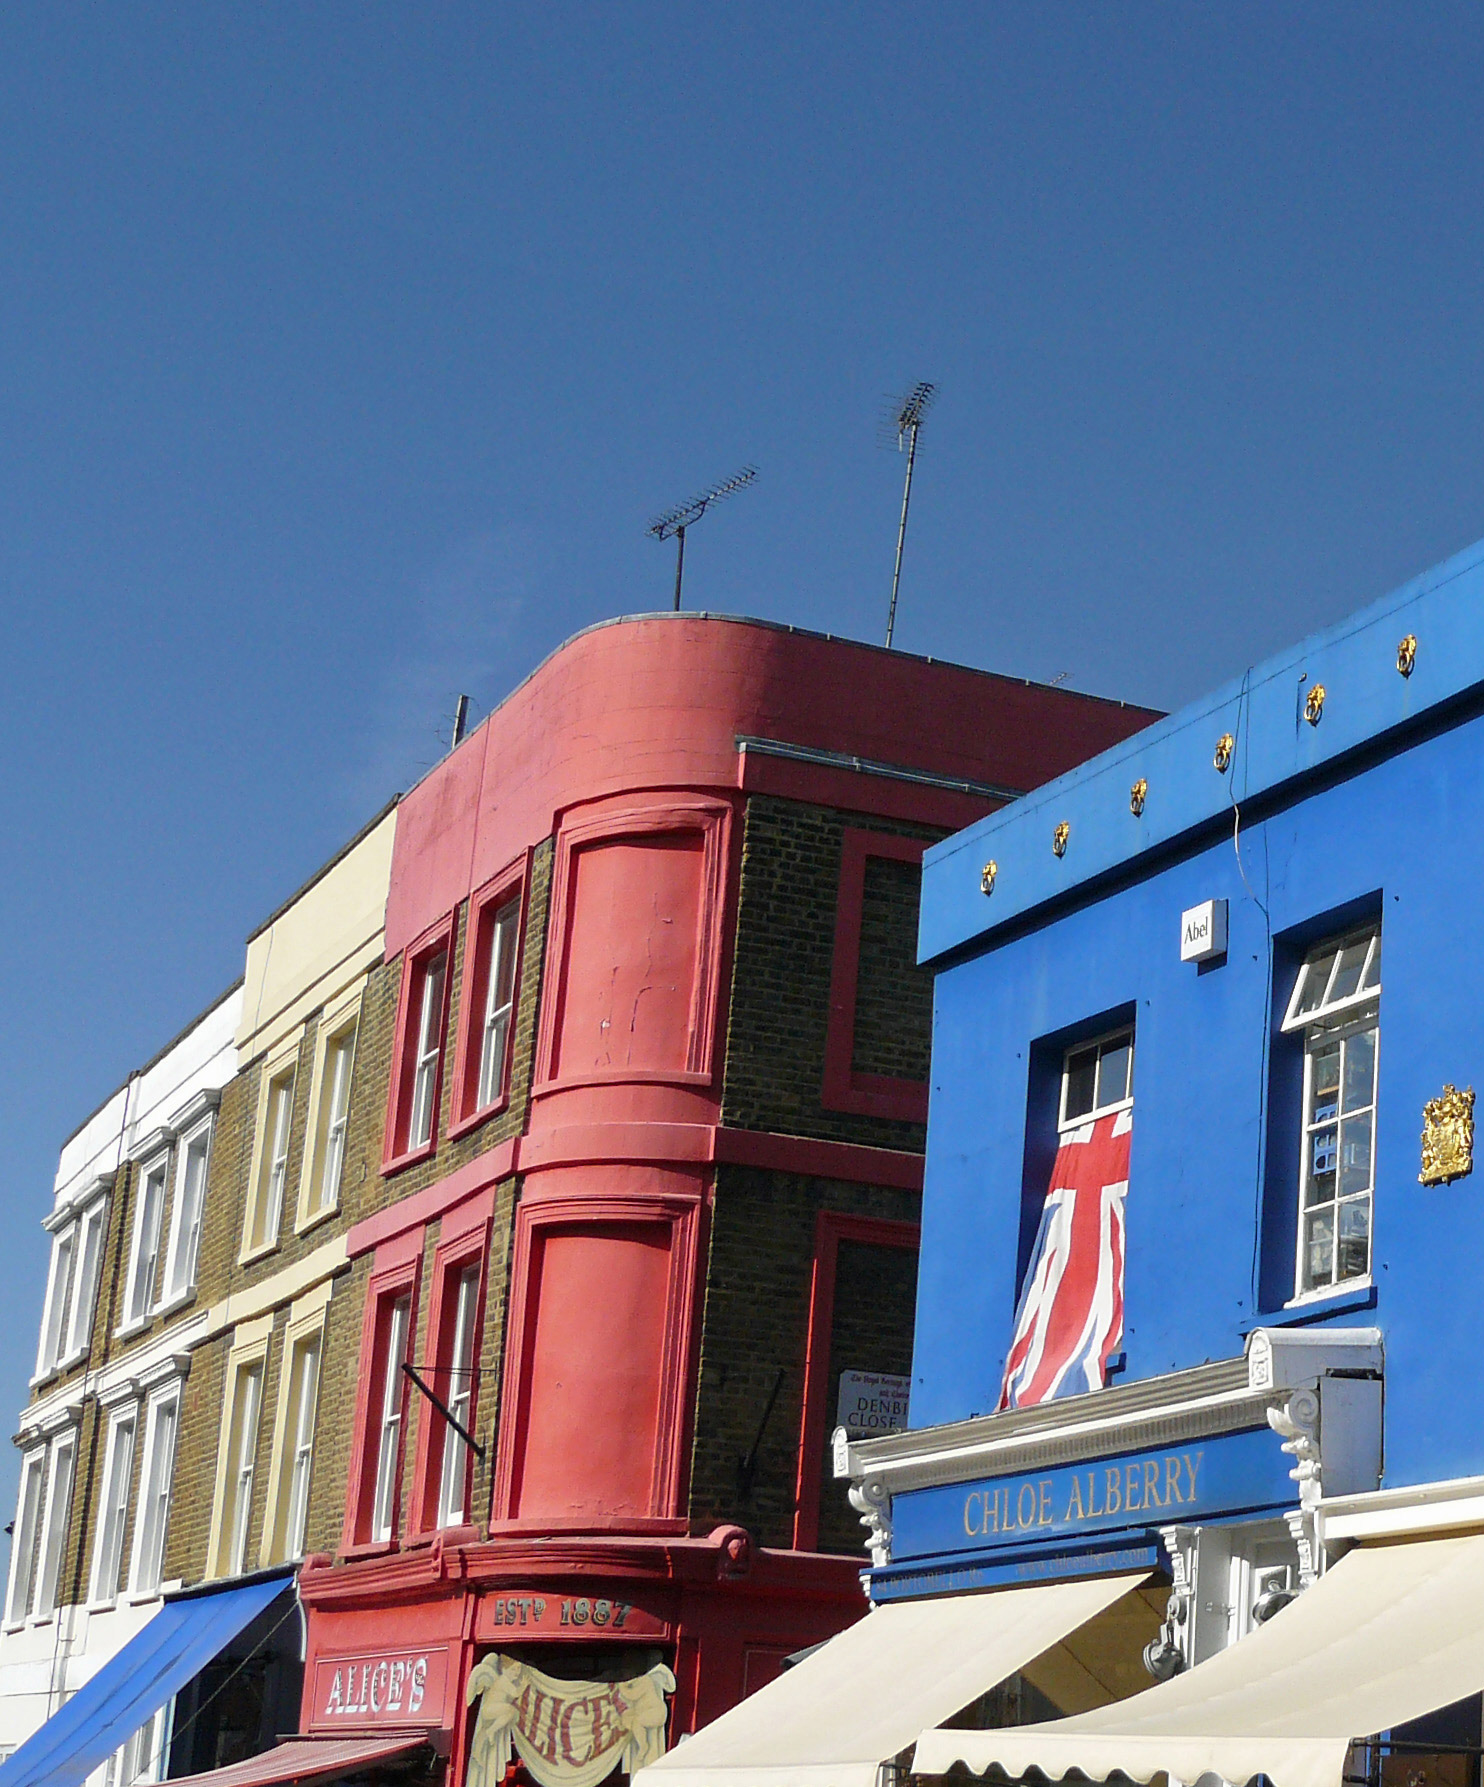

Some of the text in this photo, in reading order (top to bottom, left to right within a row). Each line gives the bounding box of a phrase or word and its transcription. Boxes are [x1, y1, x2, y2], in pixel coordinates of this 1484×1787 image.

[1184, 916, 1208, 944] Abel
[848, 1412, 897, 1429] CLOSE
[963, 1452, 1205, 1536] CHLOE ALBERRY
[560, 1598, 633, 1627] 1887
[325, 1655, 428, 1715] ALICE'S
